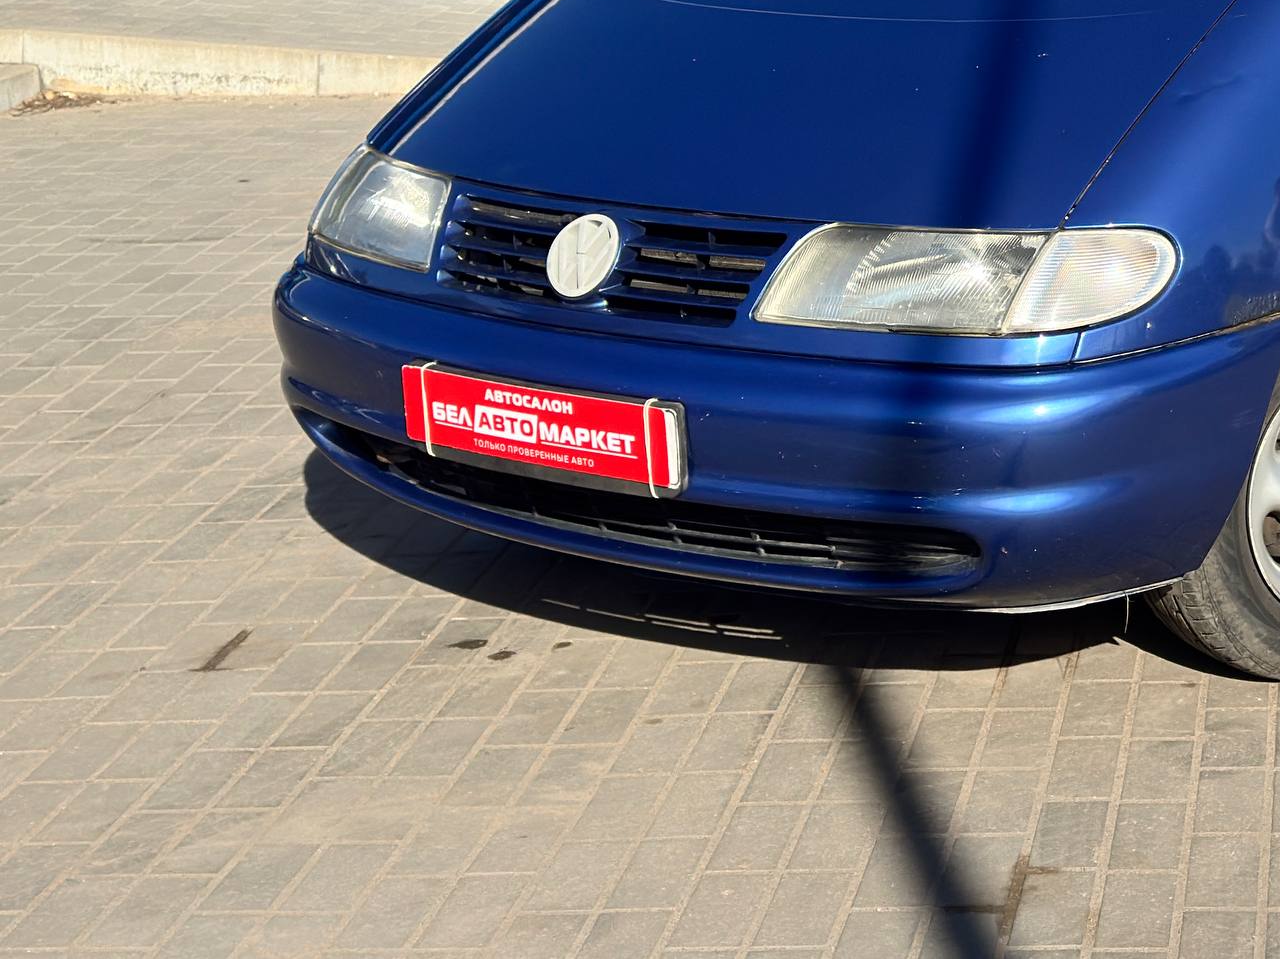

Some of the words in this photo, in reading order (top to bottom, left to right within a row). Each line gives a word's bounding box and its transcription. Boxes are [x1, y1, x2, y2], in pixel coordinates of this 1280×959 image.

[484, 388, 573, 415] АВТОСАЛОН
[432, 401, 473, 427] БЕЛ
[478, 411, 534, 437] АВТО
[538, 421, 635, 454] МАРКЕТ
[473, 438, 506, 452] ТОЛЬКО
[507, 445, 569, 464] ПРОВЕРЕННЫЕ
[571, 456, 595, 468] АВТО
